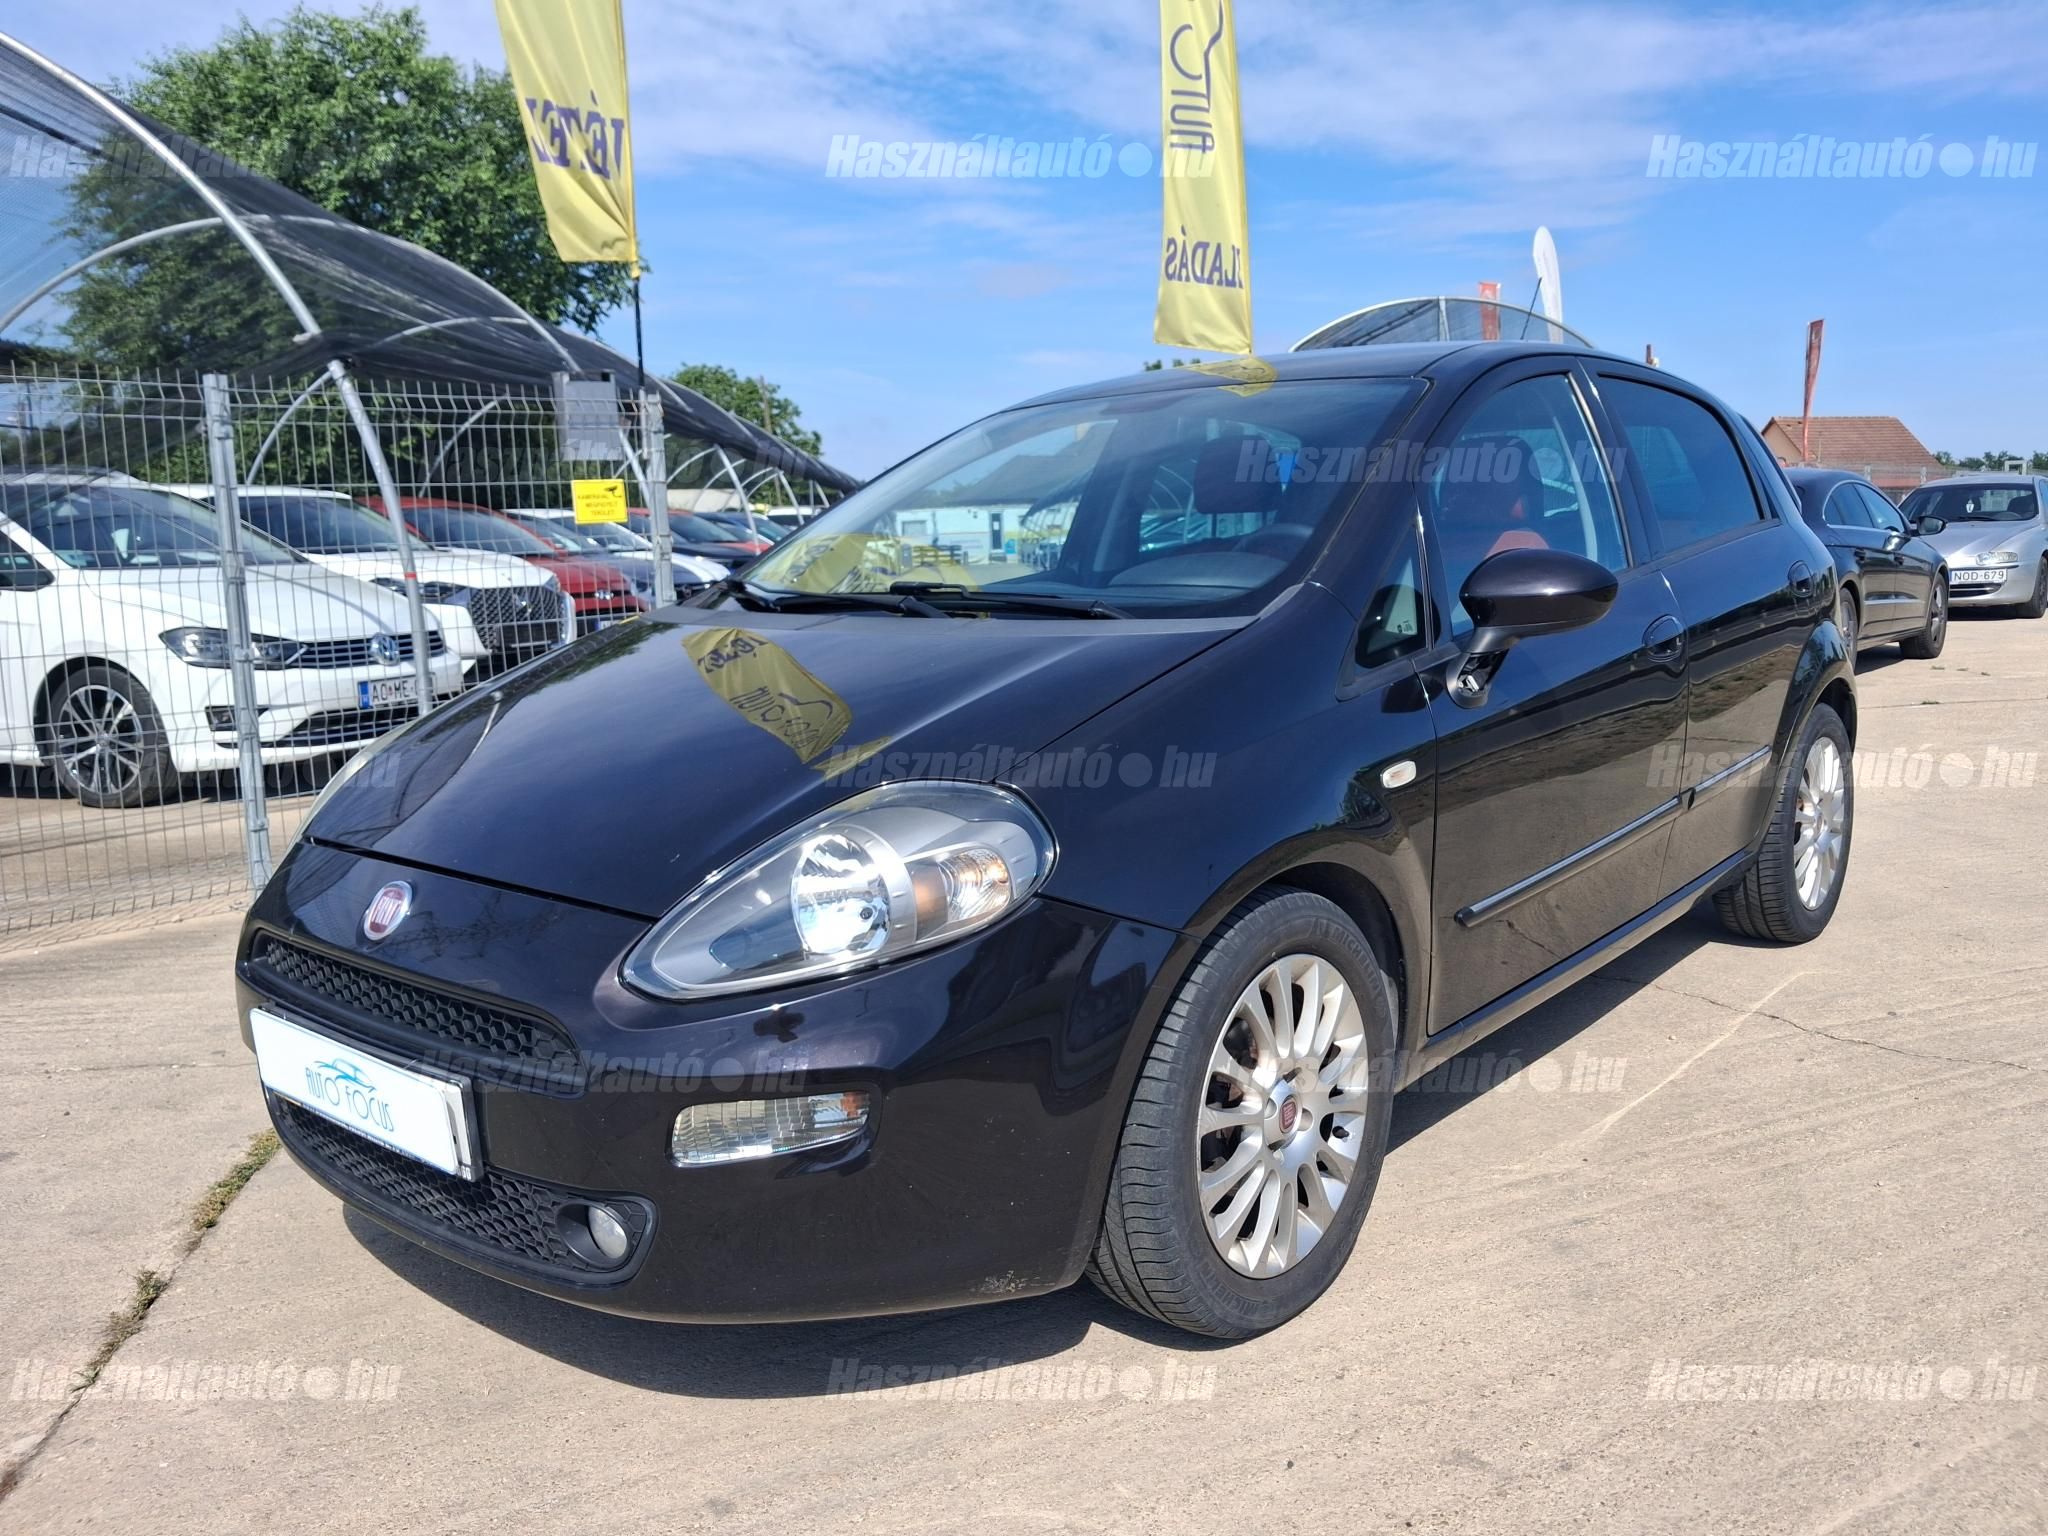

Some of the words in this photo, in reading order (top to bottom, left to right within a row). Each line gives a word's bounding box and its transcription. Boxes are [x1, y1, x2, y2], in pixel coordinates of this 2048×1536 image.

[1953, 570, 2004, 581] NOD-679
[304, 1066, 341, 1107] AUTO
[345, 1085, 395, 1133] FOCUS
